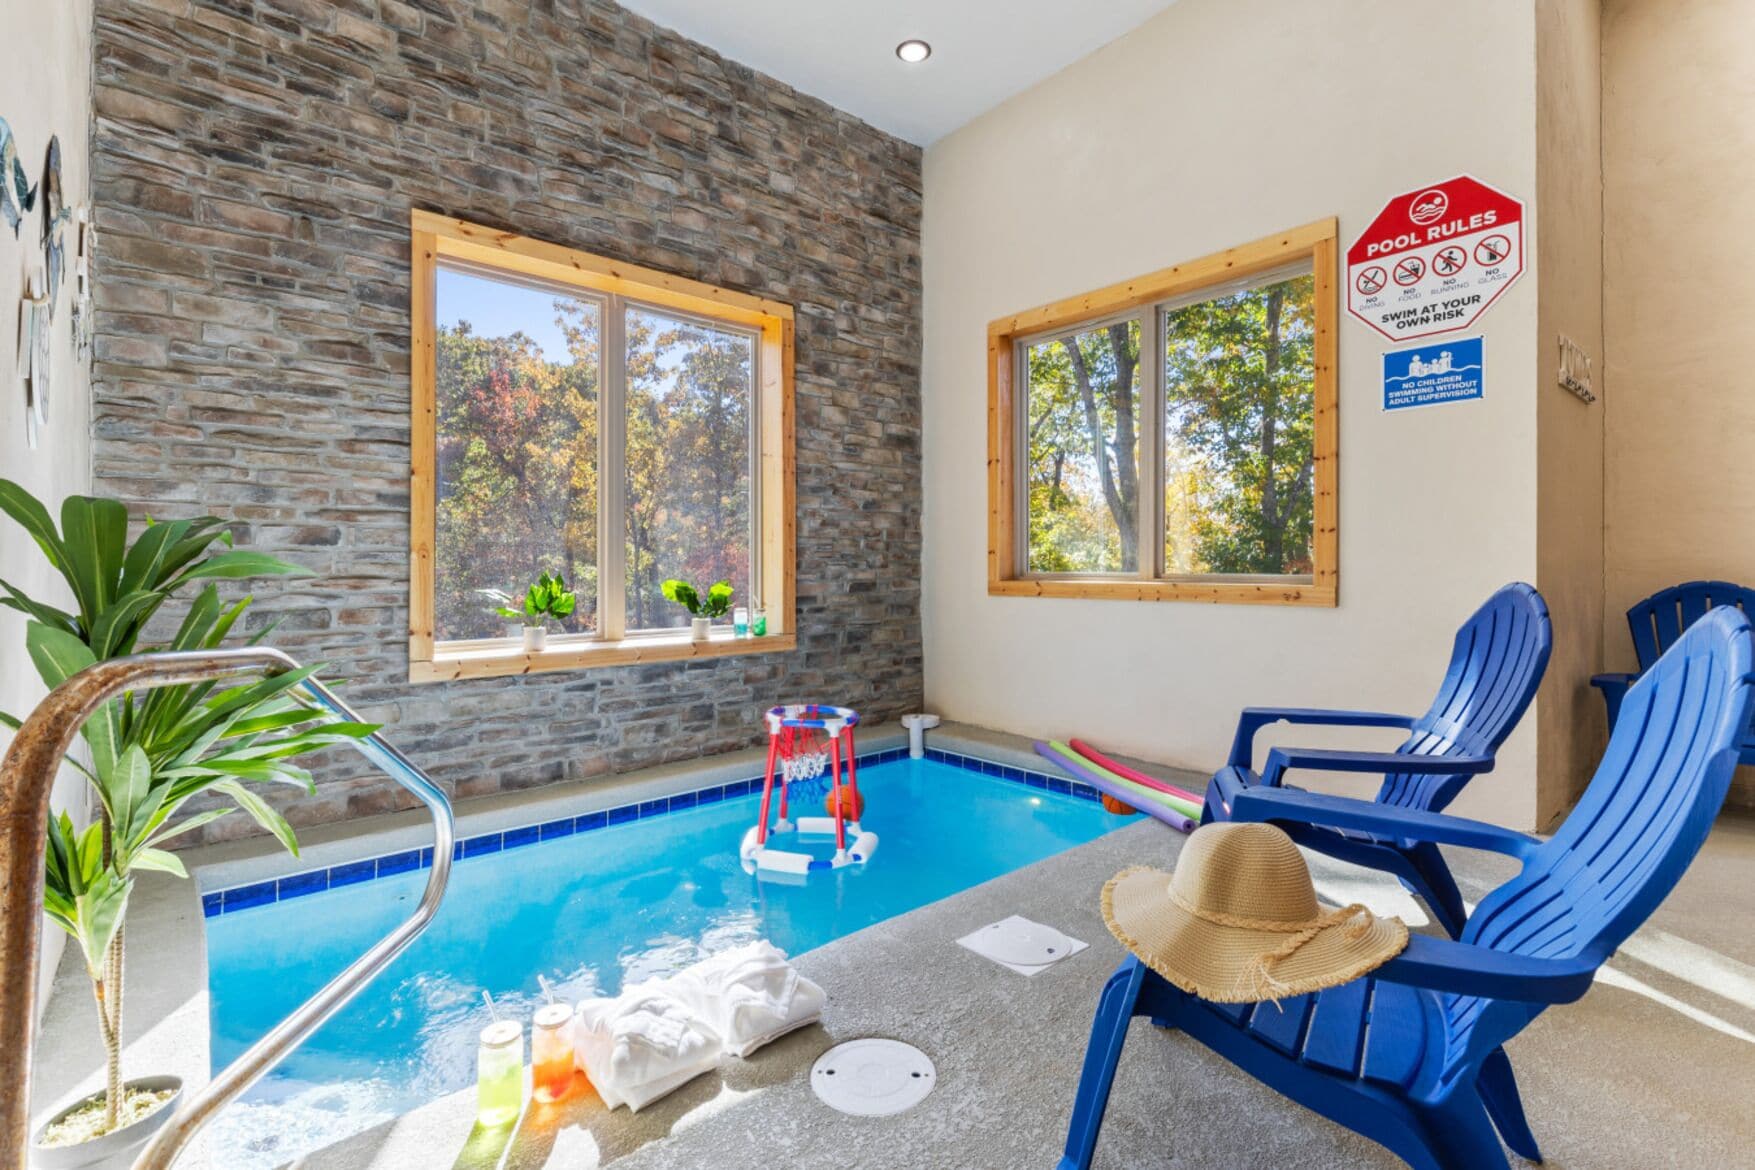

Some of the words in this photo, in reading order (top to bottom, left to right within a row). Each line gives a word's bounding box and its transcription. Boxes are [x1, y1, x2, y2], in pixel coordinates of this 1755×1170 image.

[1367, 232, 1421, 257] POOL
[1427, 210, 1497, 240] RULES
[1485, 268, 1500, 276] NO
[1443, 278, 1456, 286] NO
[1478, 273, 1508, 284] GLASS
[1403, 287, 1416, 295] NO
[1430, 282, 1469, 295] RUNNING
[1398, 293, 1422, 302] FOOD
[1359, 301, 1385, 311] DIVING
[1382, 308, 1417, 323] SWIM
[1421, 304, 1439, 315] AT
[1441, 295, 1481, 309] YOUR
[1396, 317, 1428, 329] OWN
[1434, 308, 1464, 323] RISK
[1417, 375, 1462, 387] CHILDREN
[1389, 386, 1433, 398] SWIMMING
[1436, 380, 1478, 391] WITHOUT
[1390, 396, 1416, 405] ADULT
[1418, 388, 1477, 401] SUPERVISION
